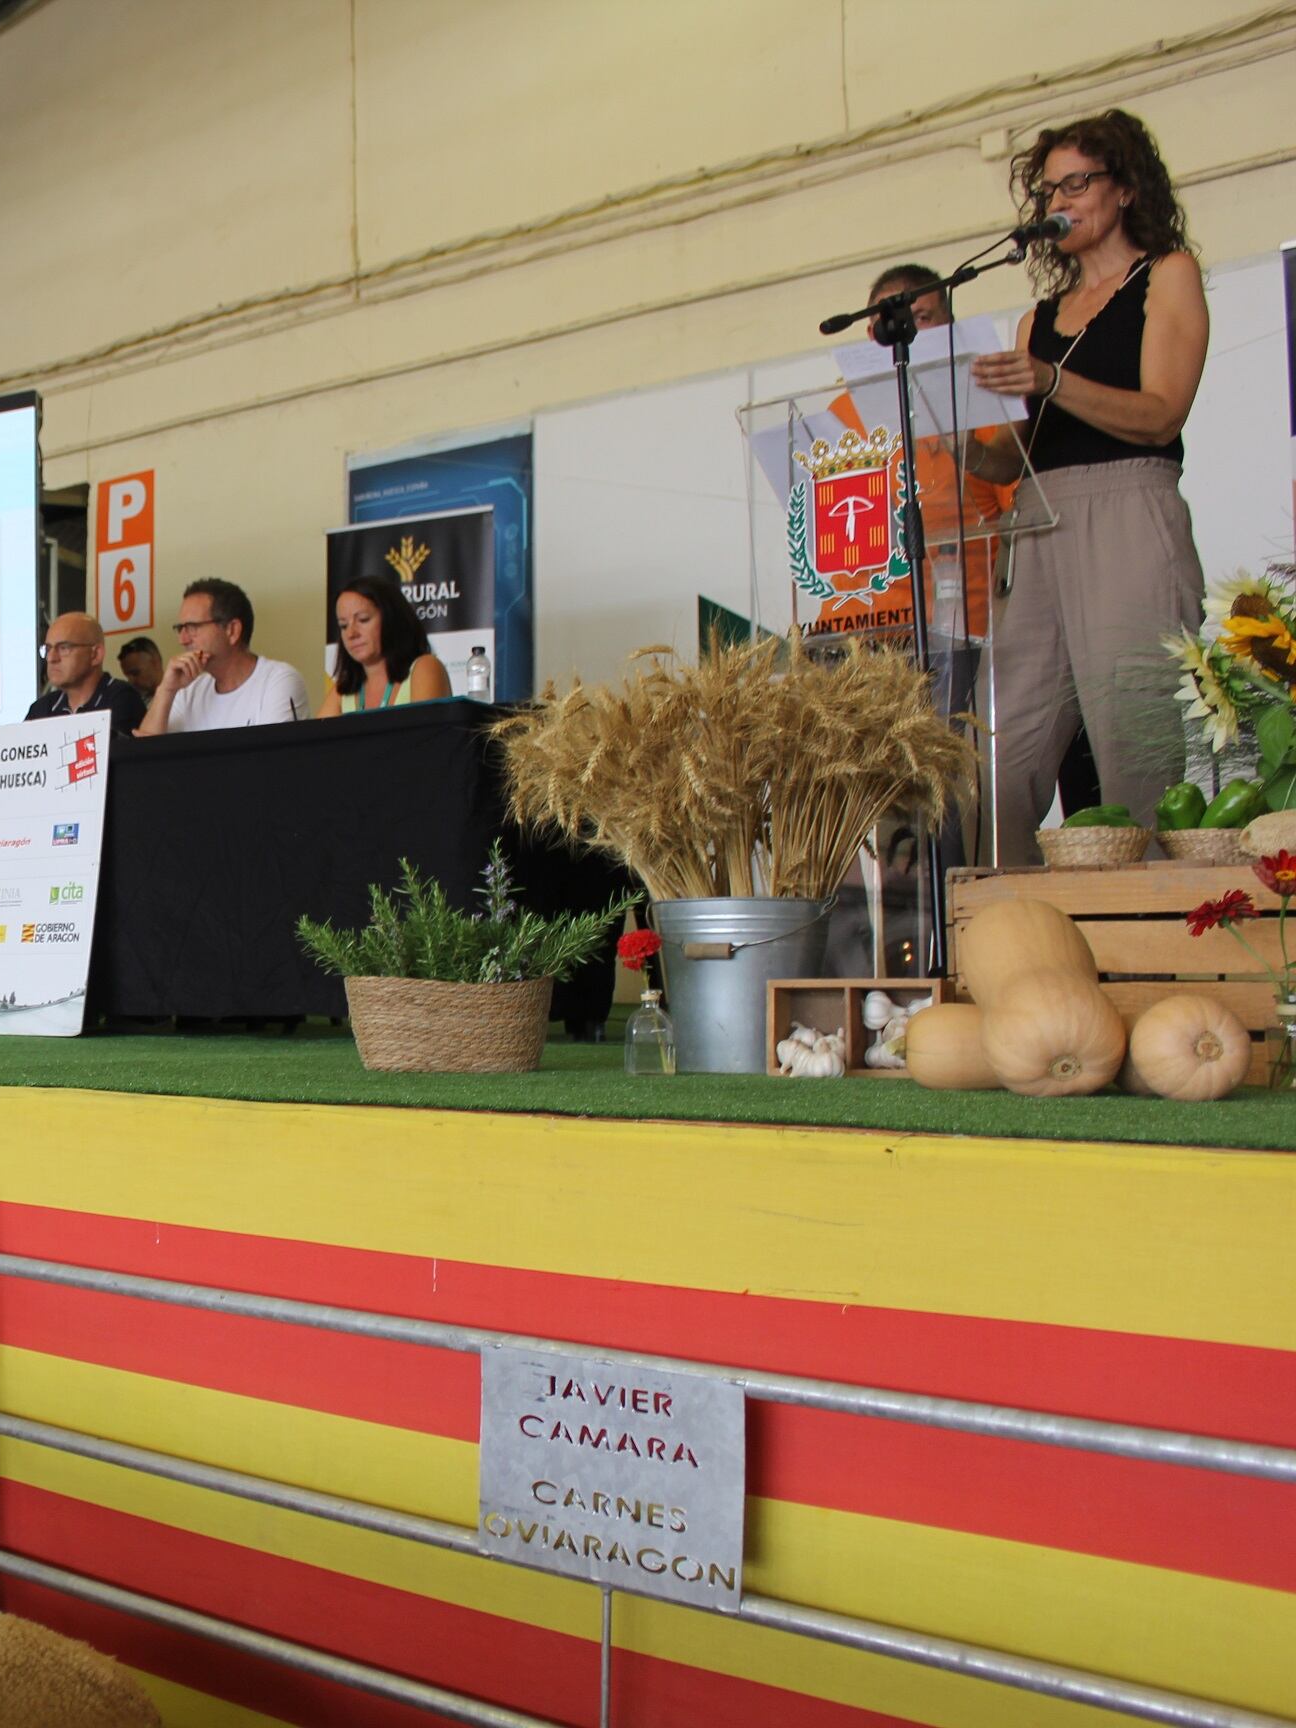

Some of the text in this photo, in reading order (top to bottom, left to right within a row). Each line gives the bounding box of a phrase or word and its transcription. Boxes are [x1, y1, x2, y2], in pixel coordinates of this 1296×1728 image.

[107, 478, 146, 544] P
[112, 557, 136, 622] 6
[401, 581, 460, 603] RURAL
[415, 603, 448, 620] GÓN
[61, 881, 84, 900] cita
[35, 934, 44, 943] DE
[36, 922, 75, 934] GOBIERNO
[544, 1375, 673, 1418] JAVIER
[519, 1414, 699, 1469] CAMARA
[531, 1480, 689, 1533] CARNES
[483, 1511, 737, 1591] OVIARAGON
